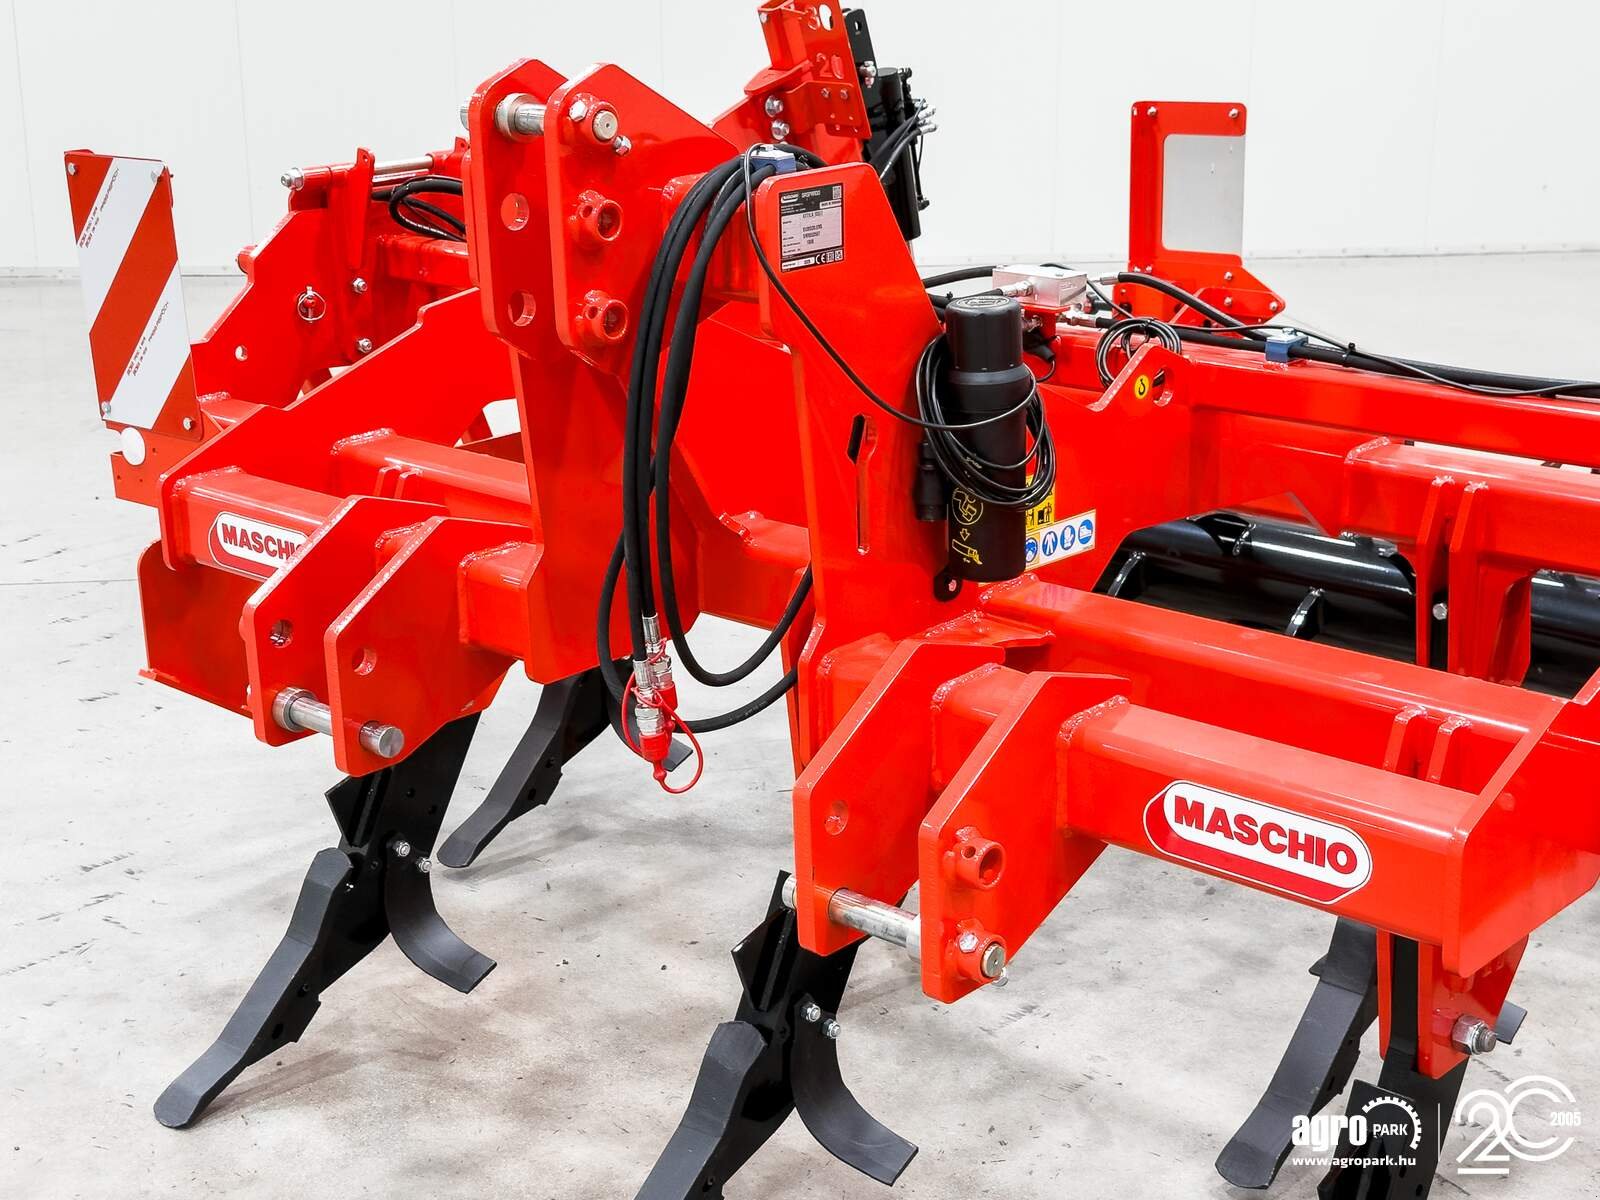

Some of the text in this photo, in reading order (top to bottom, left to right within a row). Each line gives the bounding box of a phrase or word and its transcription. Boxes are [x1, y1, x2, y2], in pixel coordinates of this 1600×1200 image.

[816, 52, 844, 80] 20
[221, 522, 302, 561] MASCHI
[1174, 795, 1357, 875] MASCHIO
